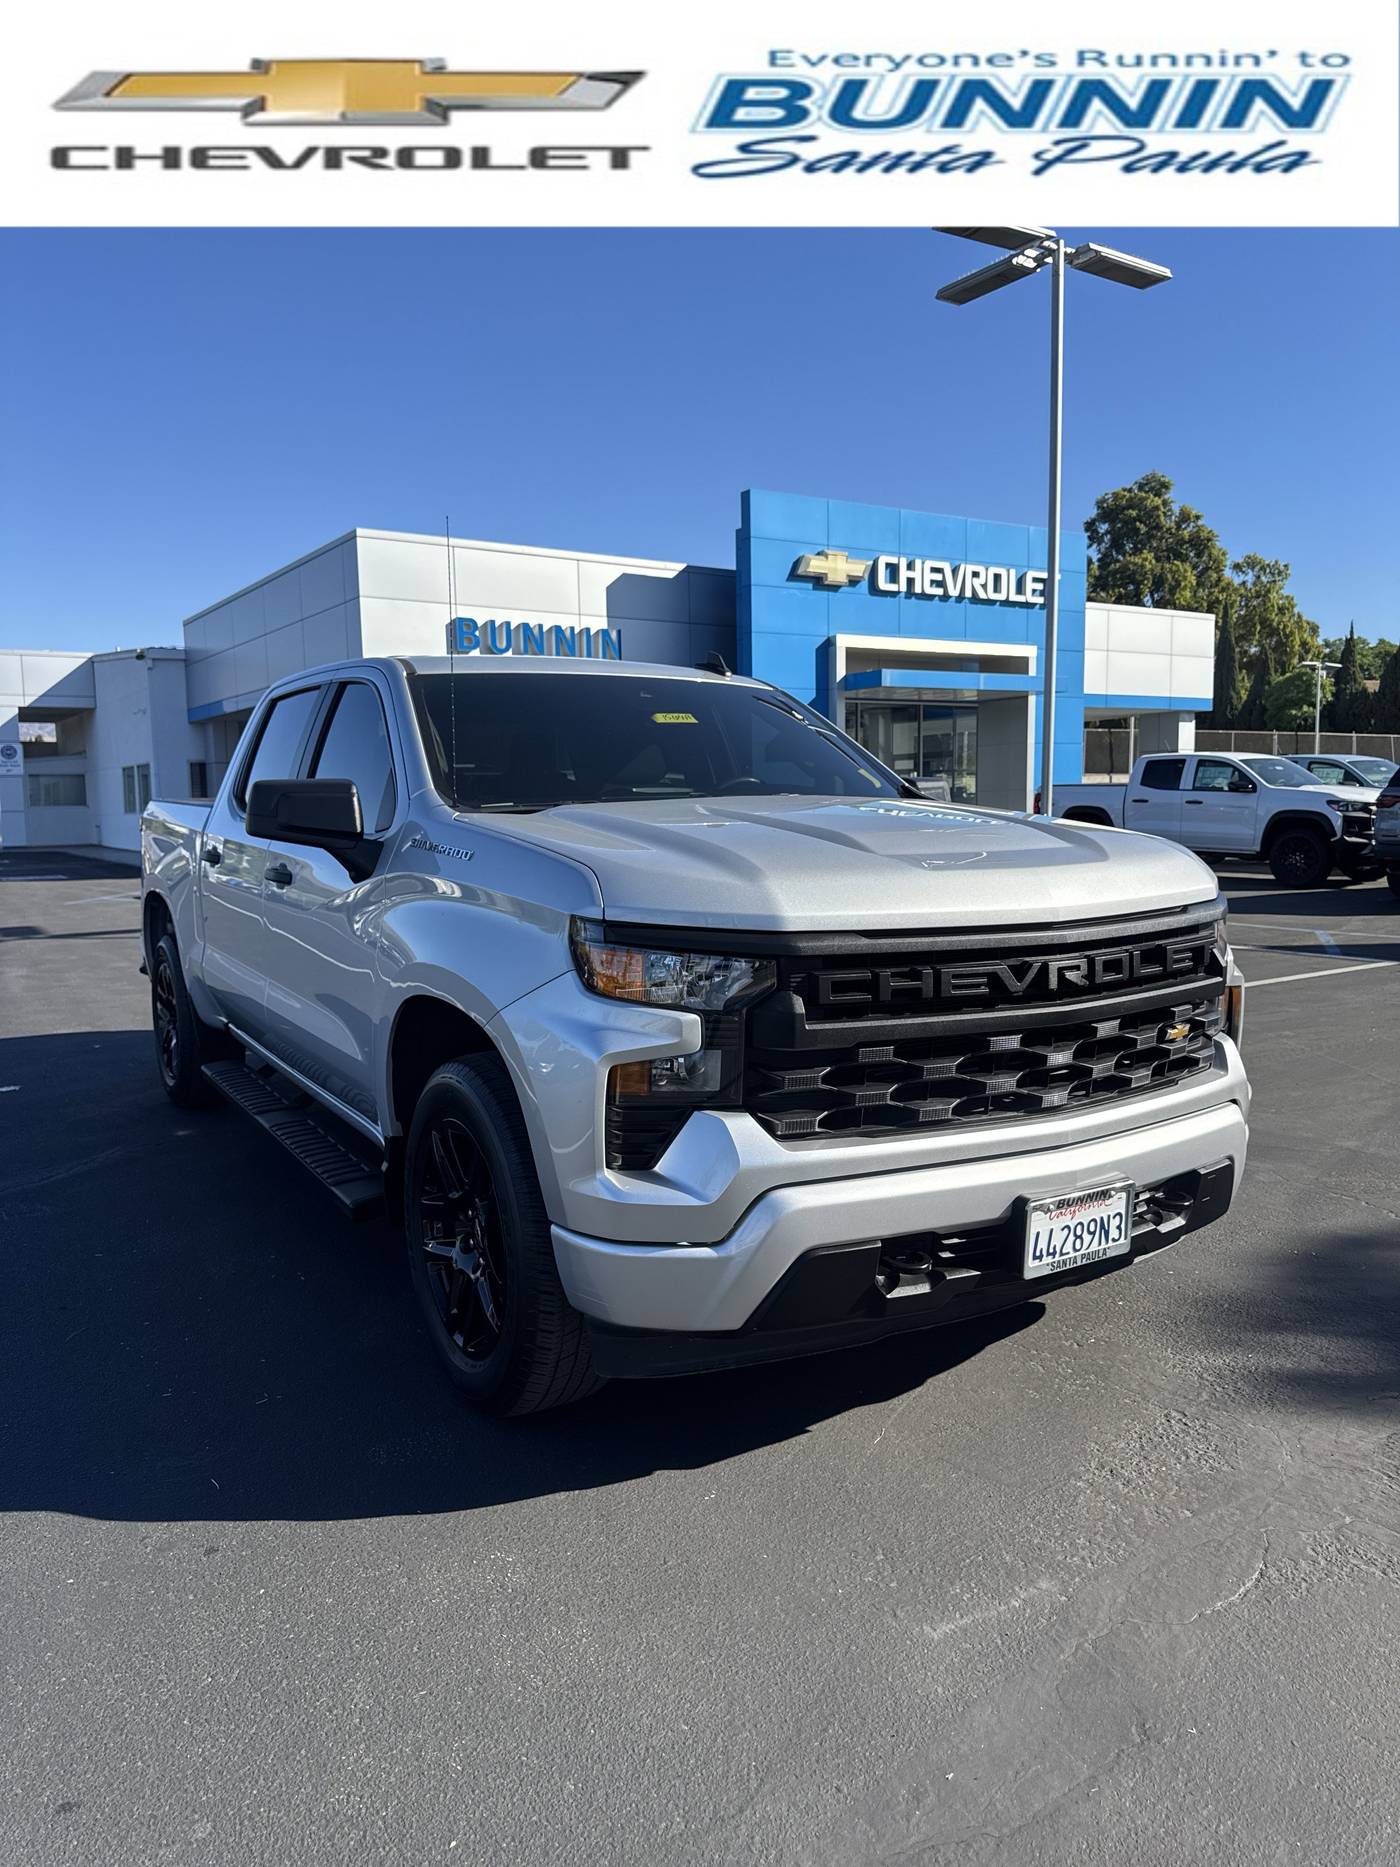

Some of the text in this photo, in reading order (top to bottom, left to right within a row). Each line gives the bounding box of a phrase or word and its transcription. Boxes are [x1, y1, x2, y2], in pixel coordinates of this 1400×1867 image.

[877, 554, 1061, 604] CHEVROLE
[447, 616, 622, 660] BUNNIN
[409, 838, 475, 861] SILVERADO
[1055, 1189, 1111, 1211] BUNNIN
[1032, 1211, 1124, 1262] 44289N3
[1049, 1249, 1108, 1272] SANTA PAULA
